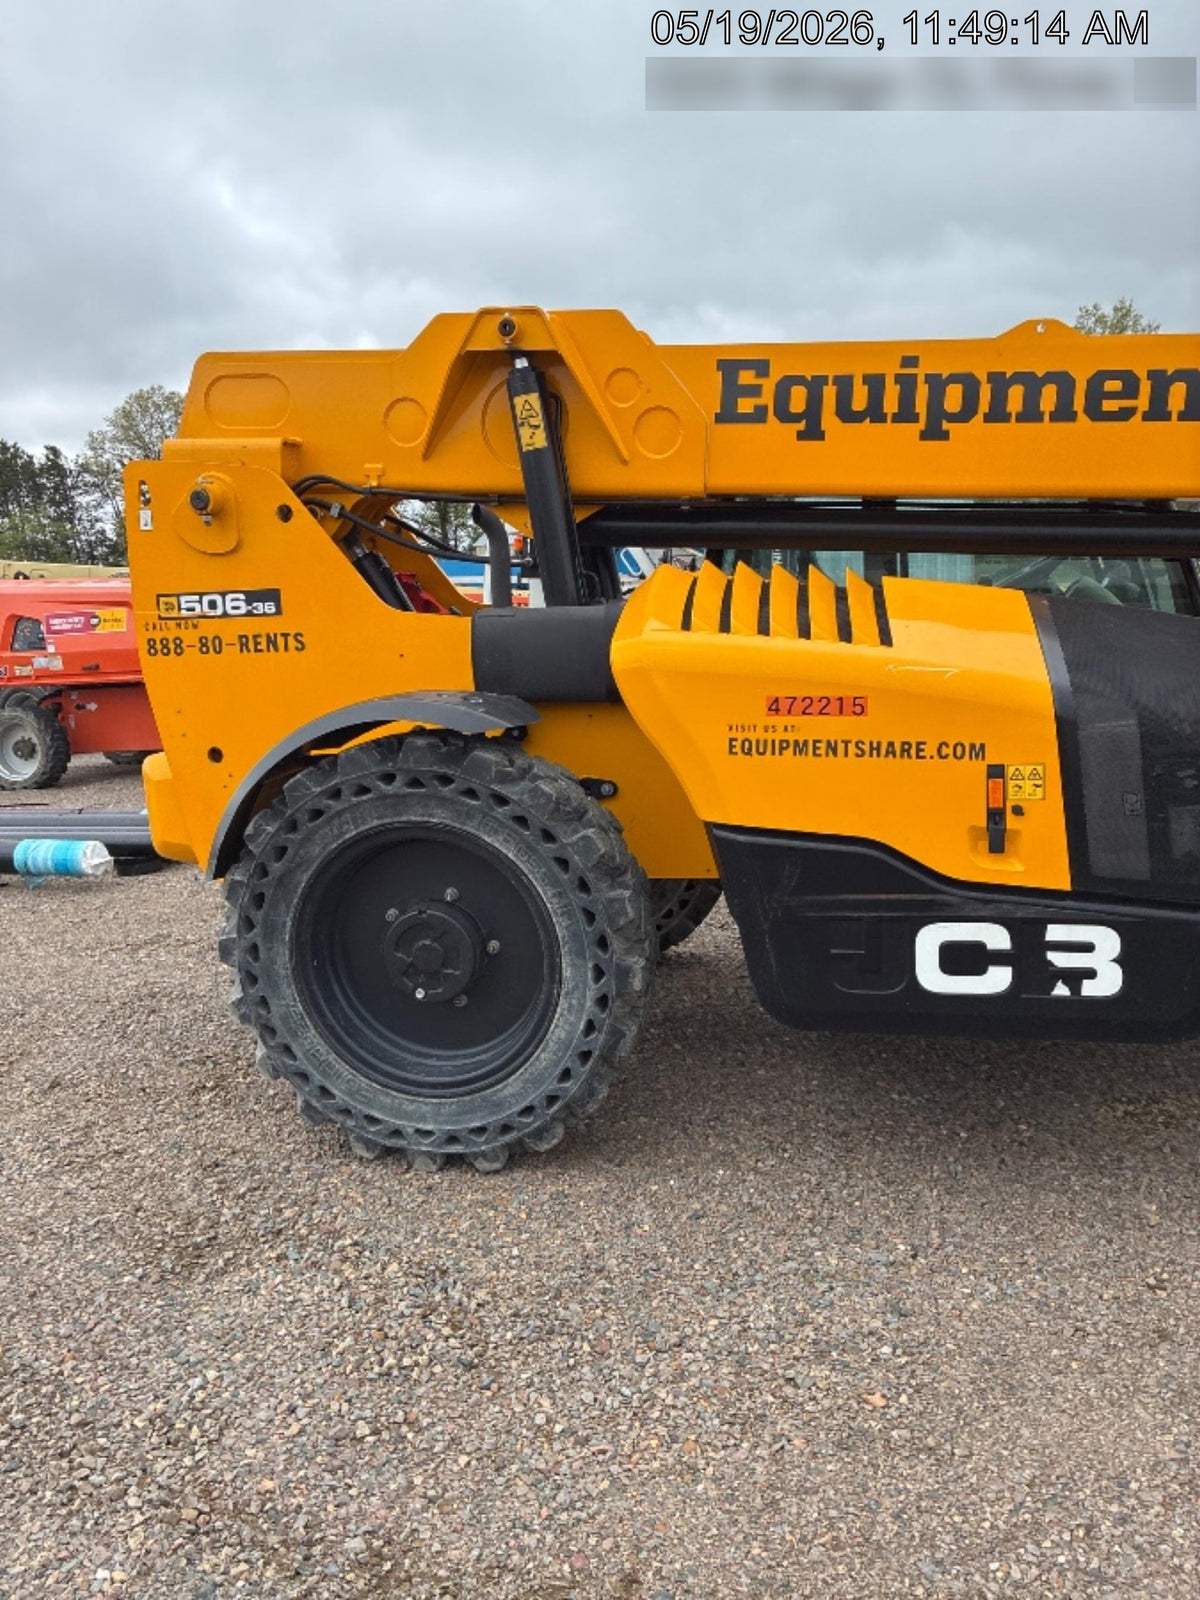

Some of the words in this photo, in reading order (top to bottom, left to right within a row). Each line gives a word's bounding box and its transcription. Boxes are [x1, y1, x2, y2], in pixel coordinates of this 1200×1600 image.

[179, 593, 276, 616] 506-36
[147, 632, 306, 657] 888-80-RENTS
[767, 695, 866, 716] 472215
[728, 724, 758, 733] VISIT
[763, 724, 778, 733] US
[727, 737, 987, 762] EQUIPMENTSHARE.COM
